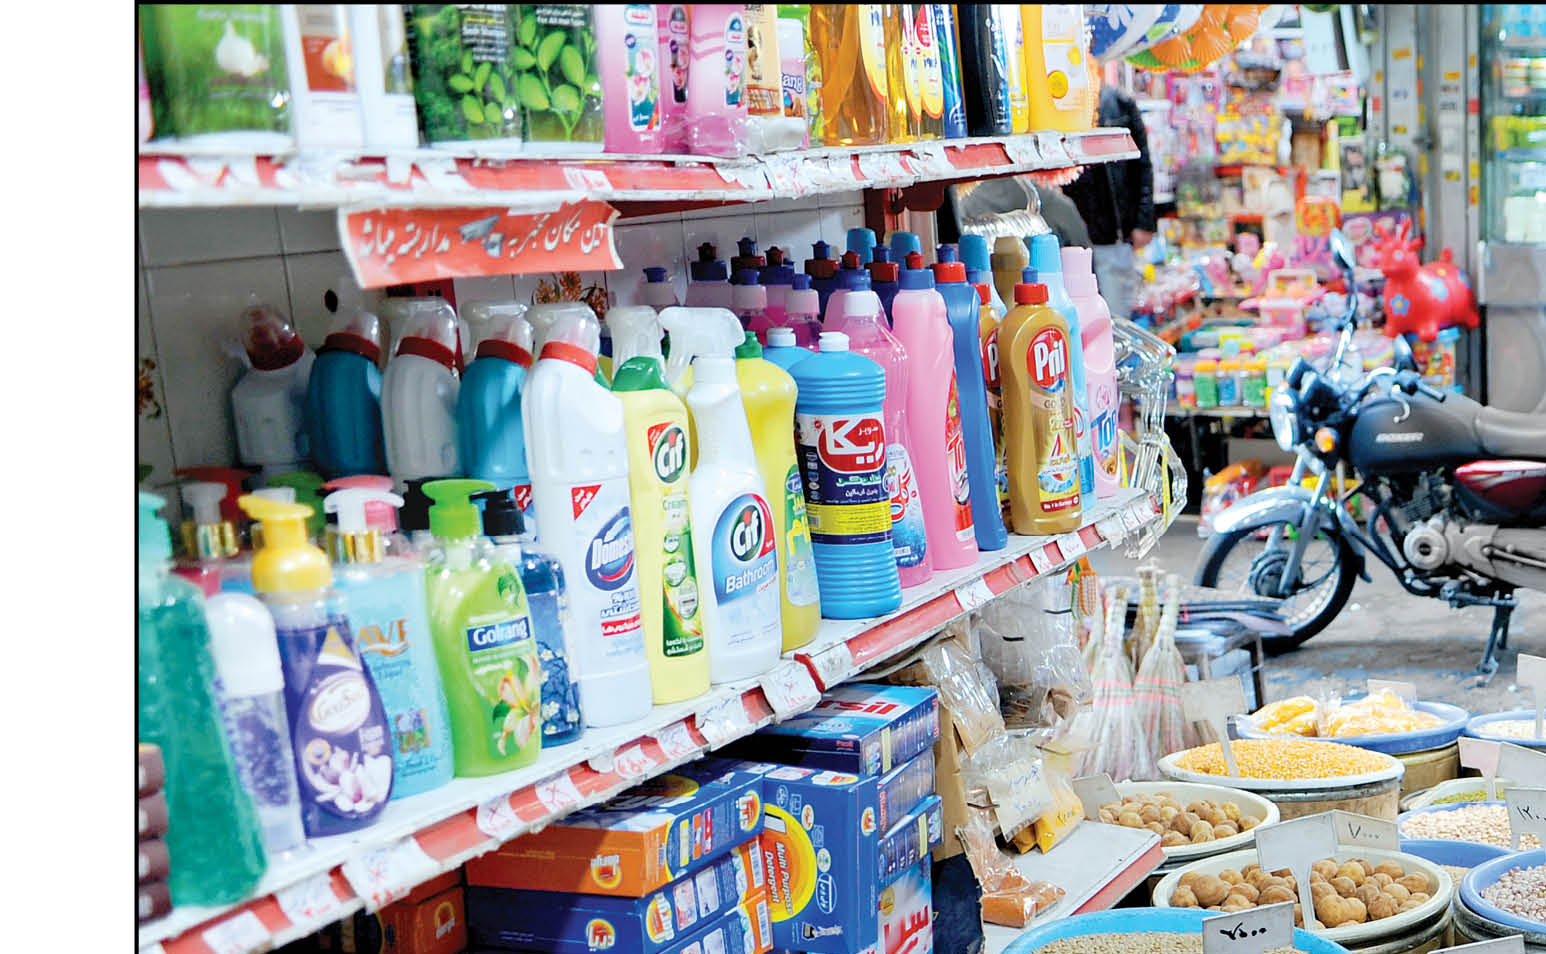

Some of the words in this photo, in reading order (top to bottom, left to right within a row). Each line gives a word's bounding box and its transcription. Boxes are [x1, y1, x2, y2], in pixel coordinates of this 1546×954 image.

[1034, 339, 1065, 382] Pril
[656, 431, 685, 478] Cif
[732, 510, 762, 553] Cif
[725, 559, 775, 594] Bathroom
[472, 619, 529, 646] Golrang
[775, 840, 789, 871] Multi
